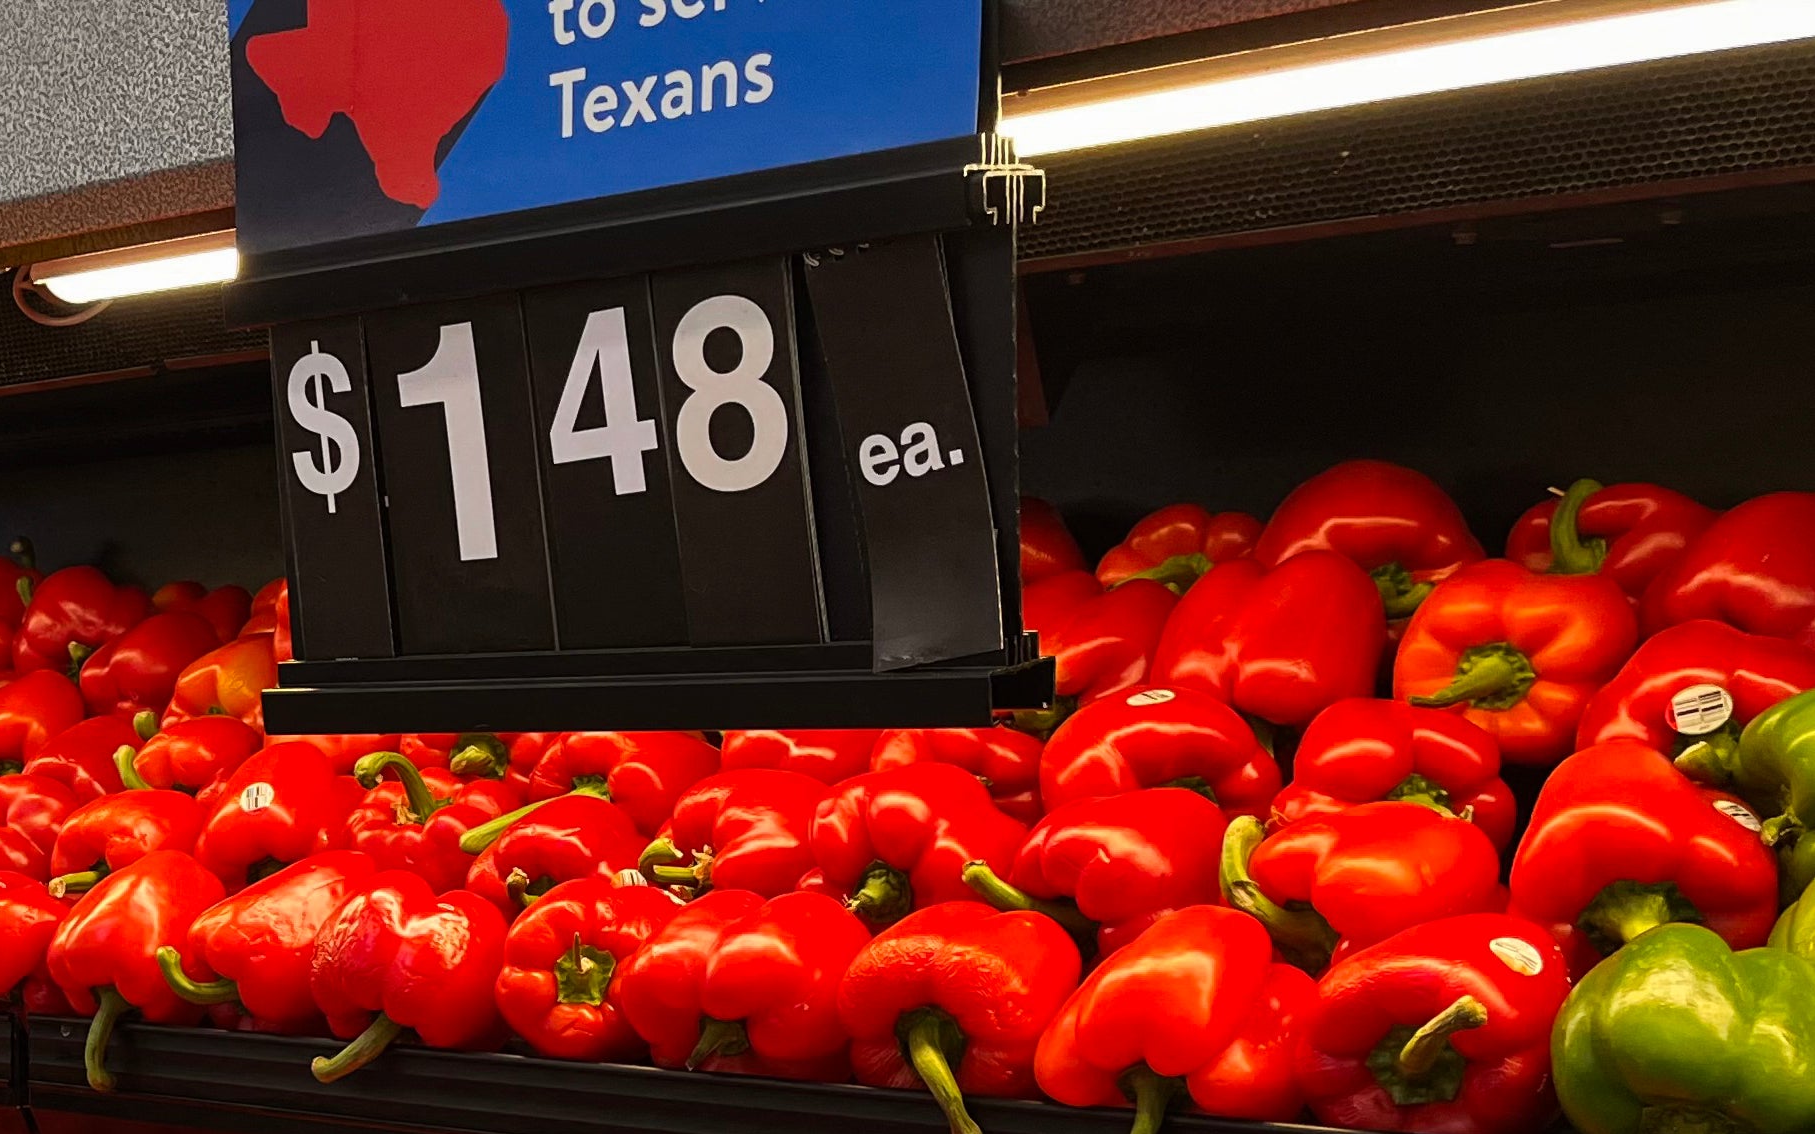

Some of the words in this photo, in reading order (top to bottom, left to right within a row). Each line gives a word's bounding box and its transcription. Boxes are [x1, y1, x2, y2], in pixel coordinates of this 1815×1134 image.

[548, 0, 616, 46] to
[549, 52, 775, 139] Texans
[858, 420, 966, 487] ea.
